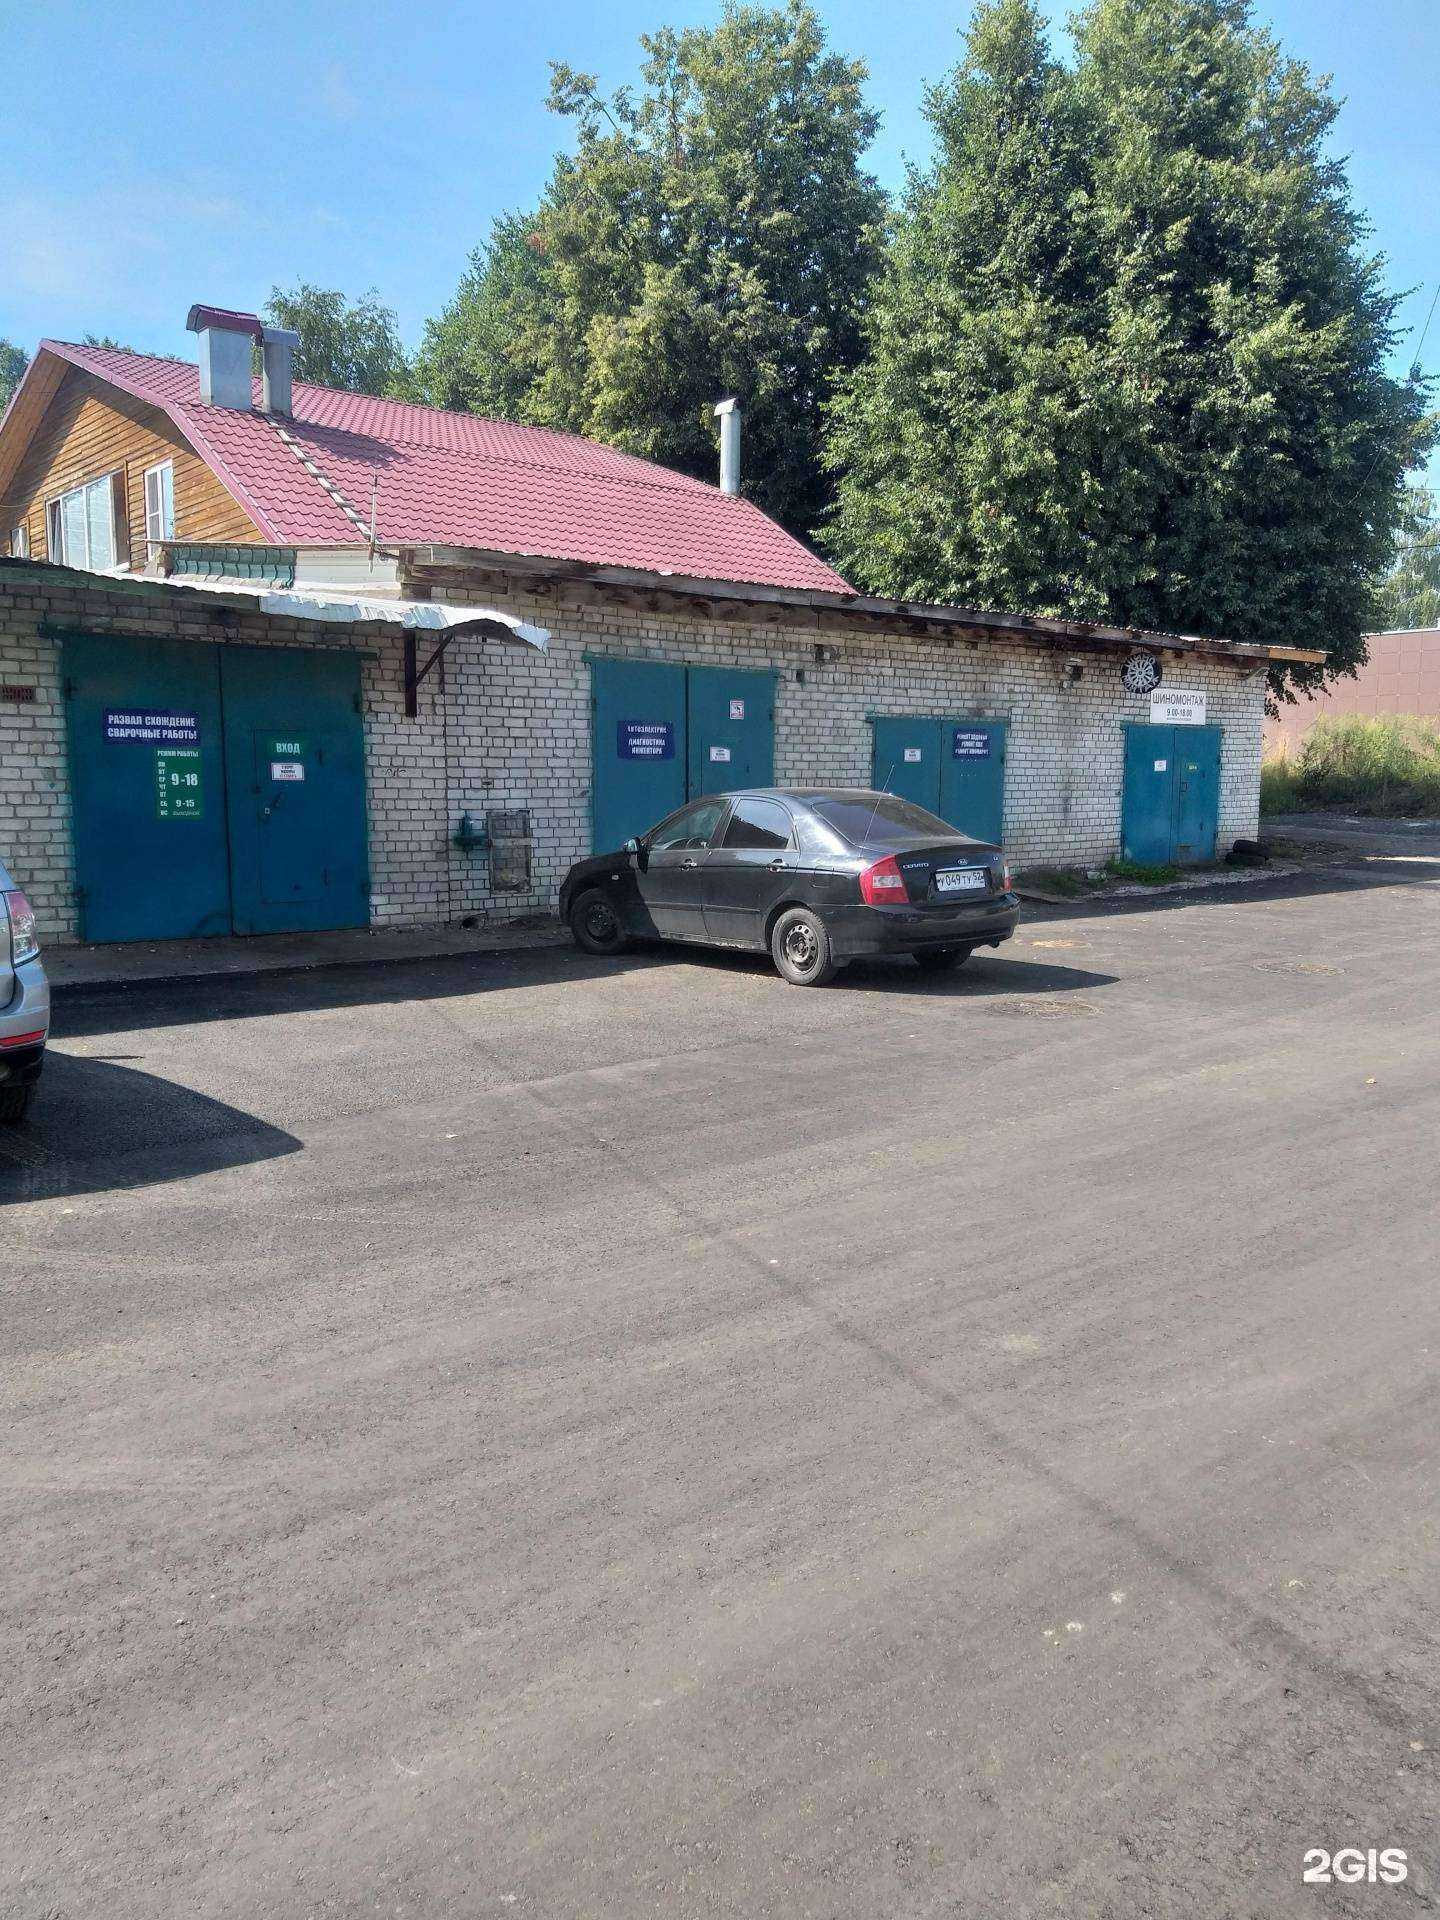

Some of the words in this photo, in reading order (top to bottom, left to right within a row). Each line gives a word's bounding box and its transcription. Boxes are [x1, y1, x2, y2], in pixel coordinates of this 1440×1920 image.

[1152, 692, 1205, 706] ШИНОМОНТАЖ
[108, 715, 143, 725] РАЗВАЛ
[145, 716, 196, 728] СХОЖДЕНИЕ
[107, 727, 161, 739] СВАРОЧНЫЕ
[276, 742, 301, 755] ВХОД
[171, 773, 198, 786] 9-18
[175, 799, 195, 808] 9-15
